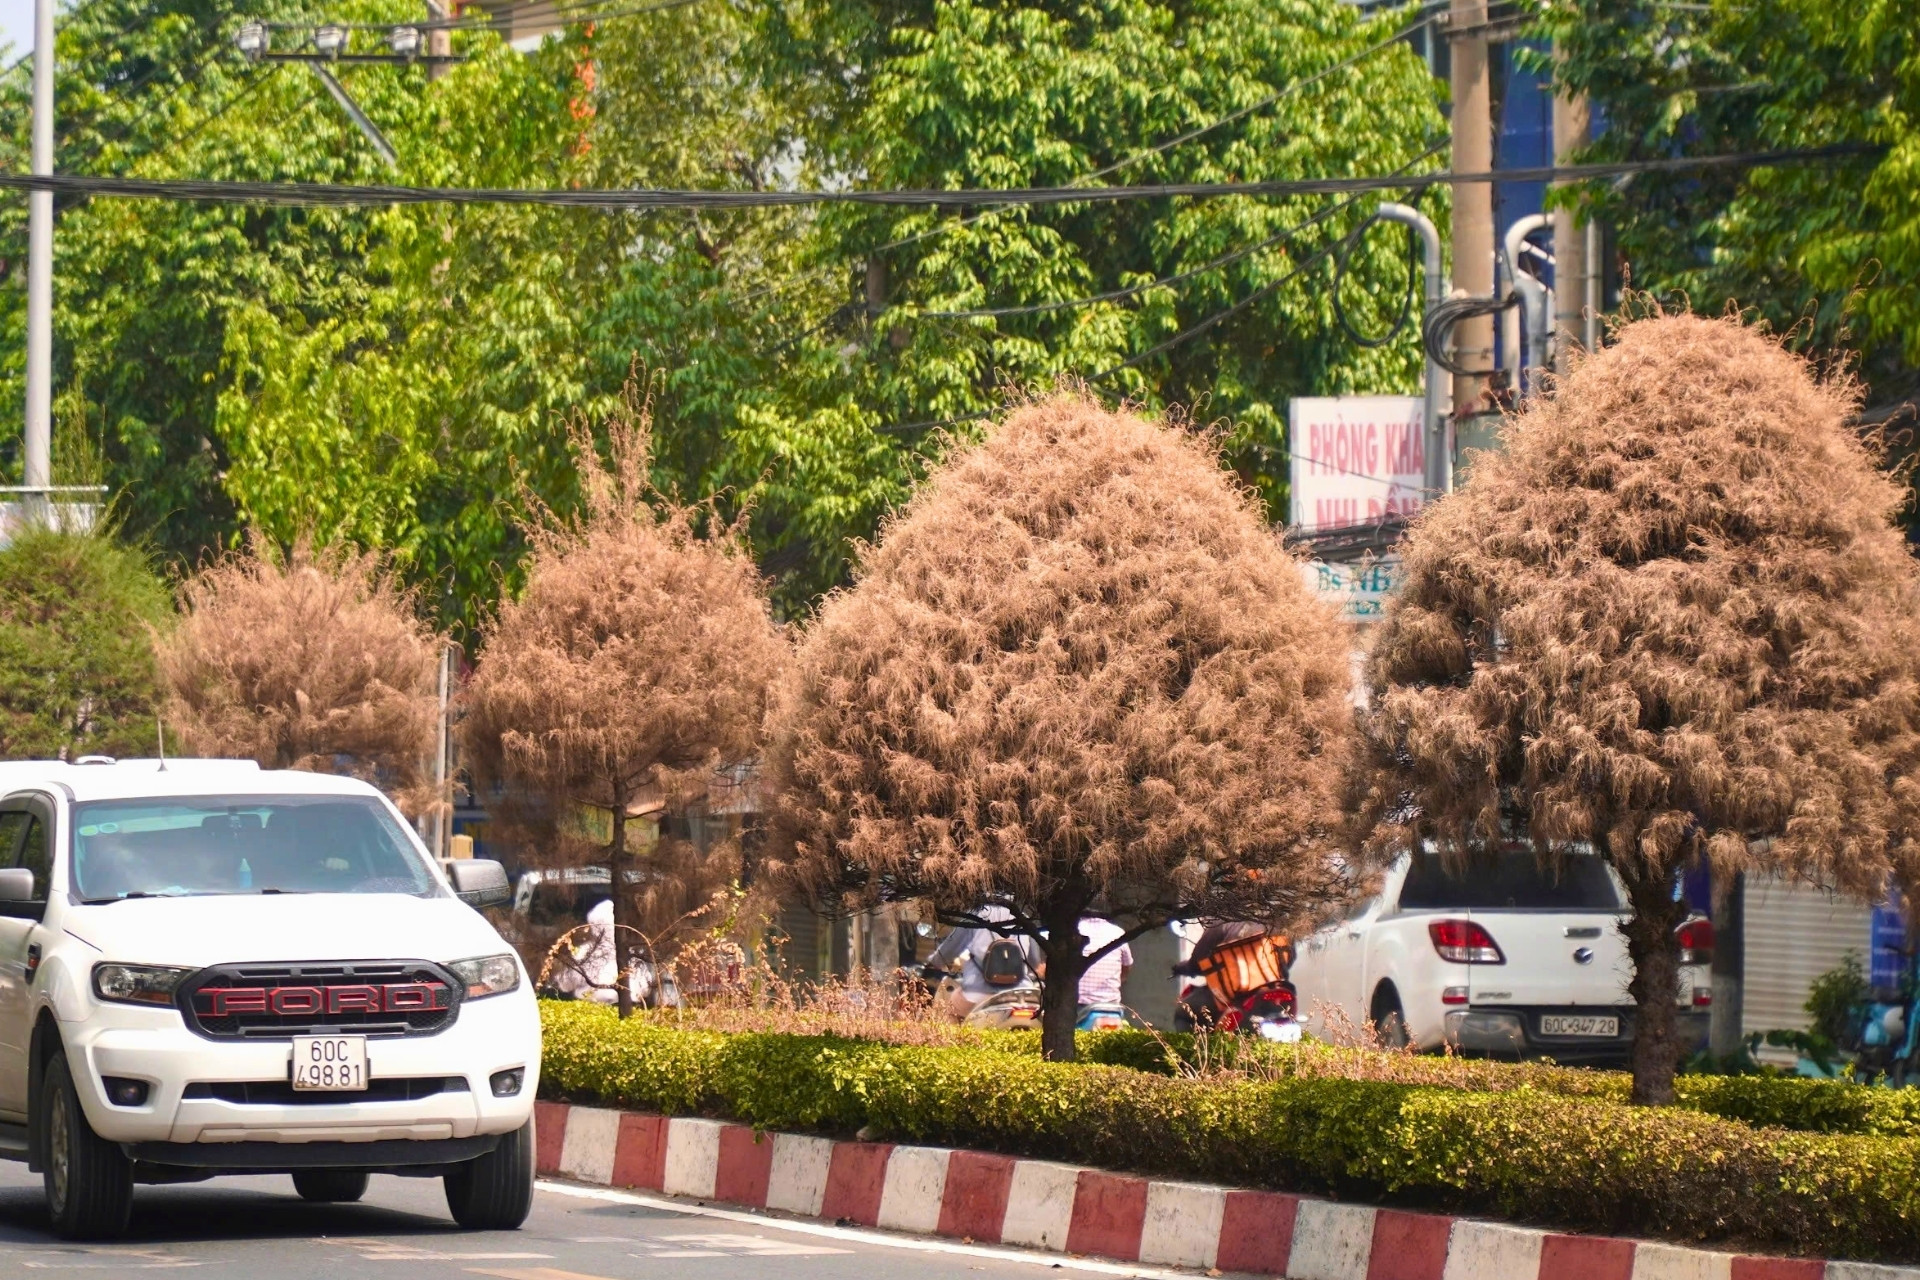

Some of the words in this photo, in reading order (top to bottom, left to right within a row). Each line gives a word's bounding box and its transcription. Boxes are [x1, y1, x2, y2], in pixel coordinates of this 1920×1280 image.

[1310, 413, 1378, 476] PHÒNG
[203, 982, 443, 1017] FORD
[311, 1040, 348, 1062] 60C
[296, 1064, 361, 1088] 498.81
